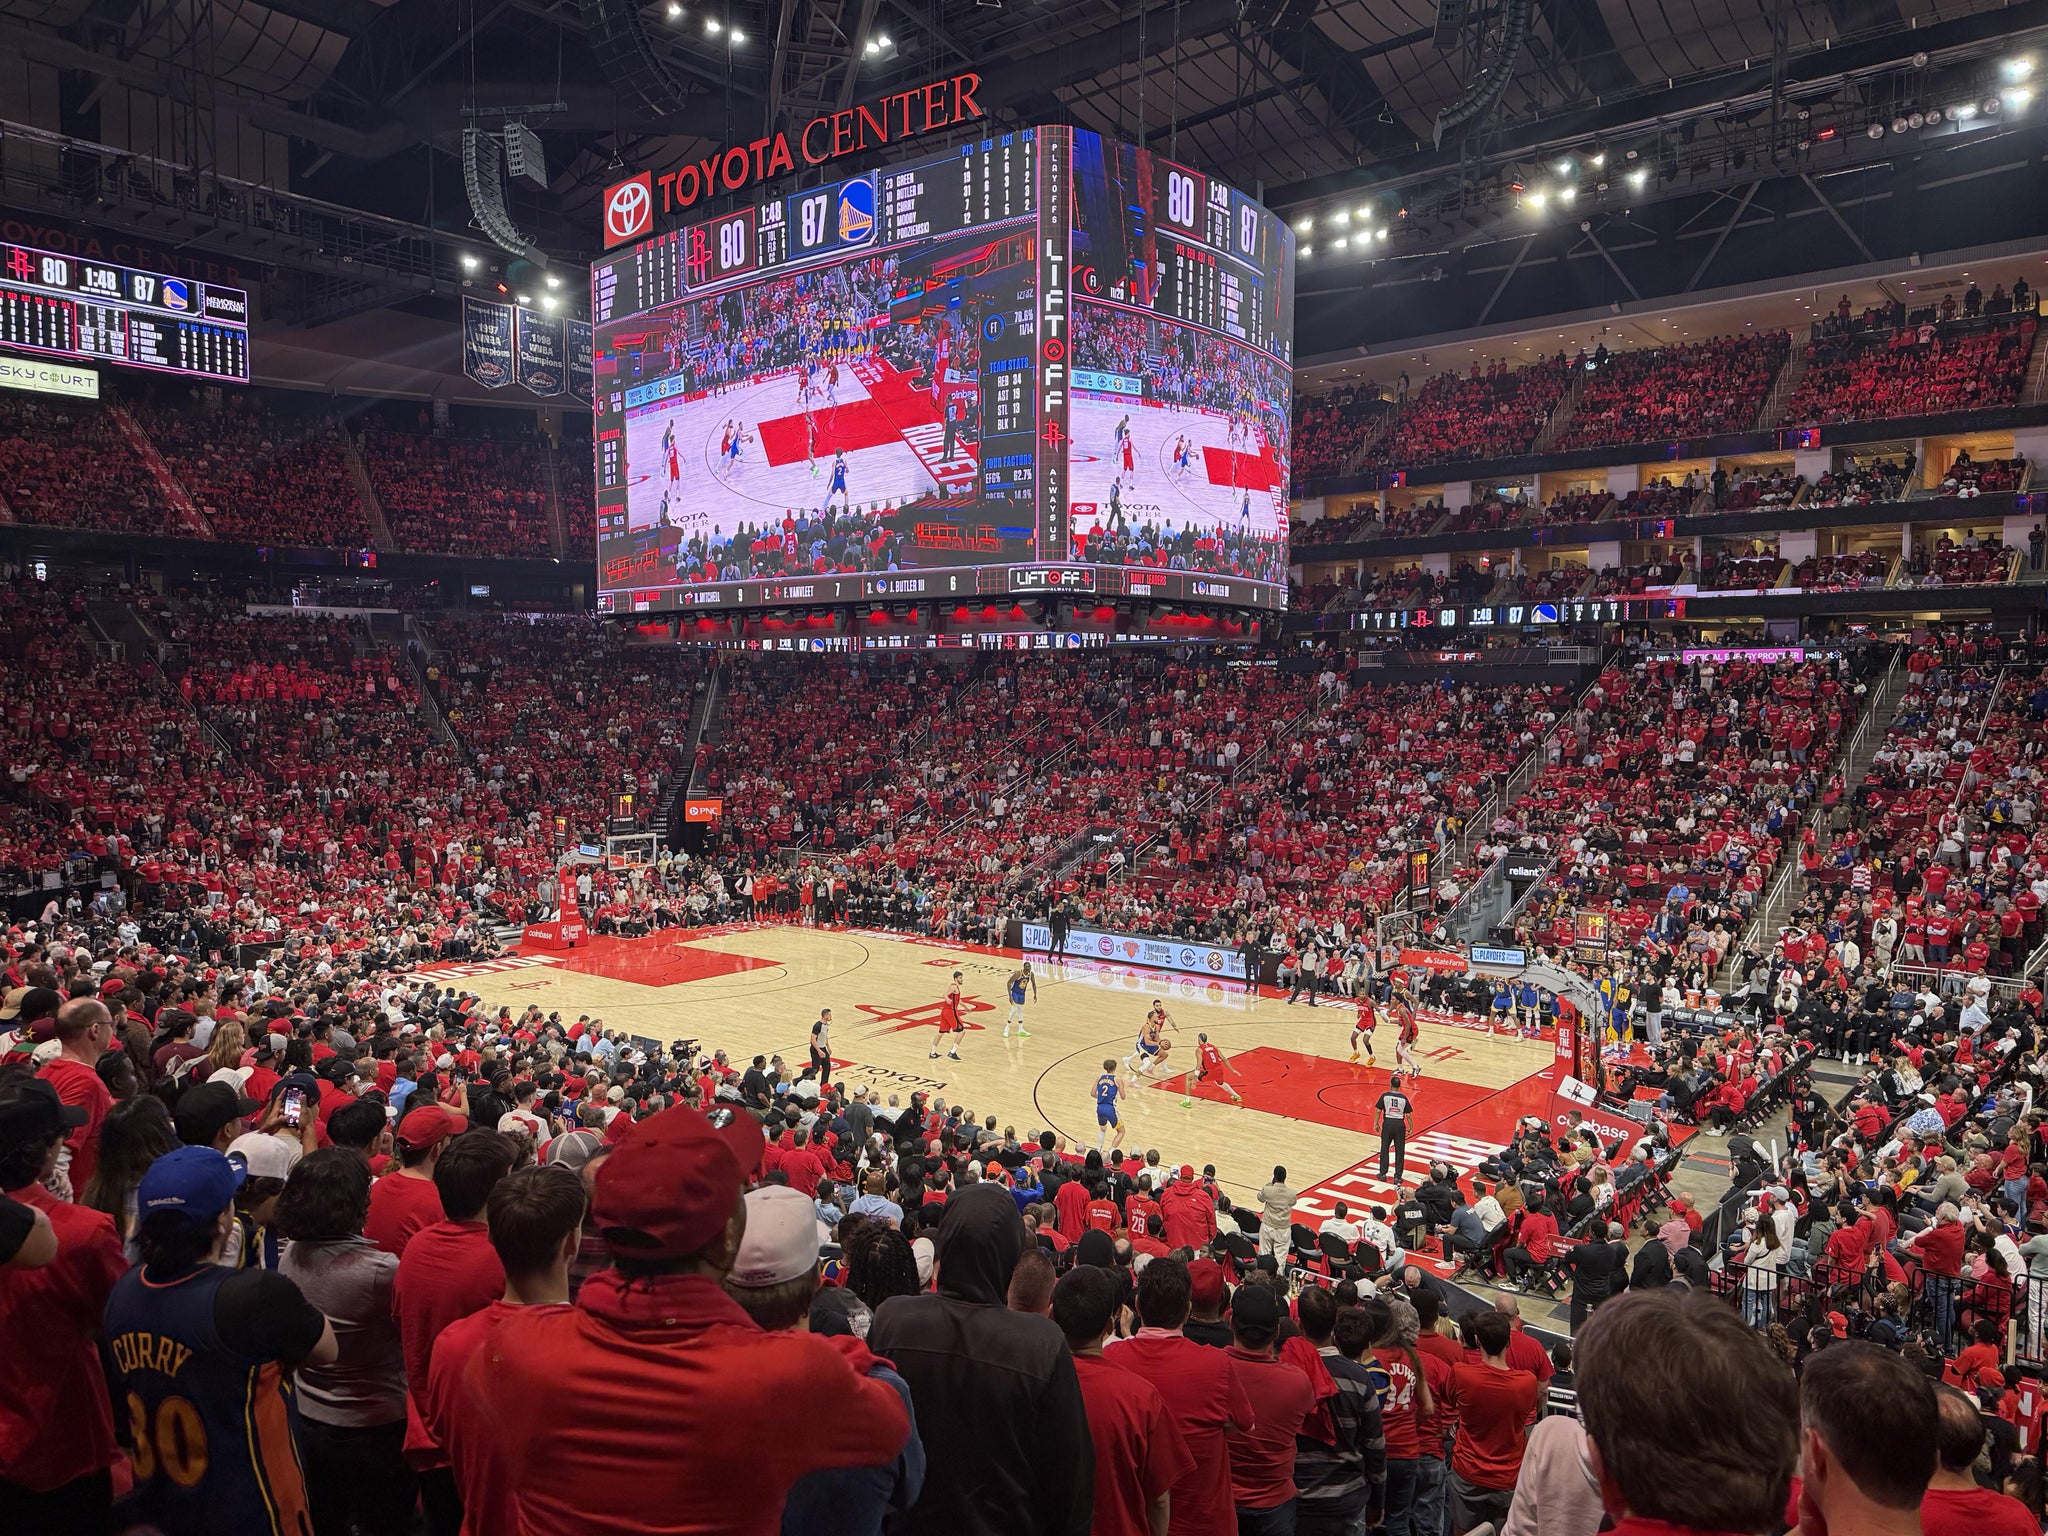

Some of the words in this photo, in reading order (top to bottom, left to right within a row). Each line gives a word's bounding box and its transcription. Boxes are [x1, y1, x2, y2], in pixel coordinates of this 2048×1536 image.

[658, 132, 795, 213] TOYOTA
[800, 72, 983, 165] CENTER
[961, 144, 974, 157] PTS
[981, 139, 993, 152] REB
[1001, 133, 1013, 147] AST
[964, 157, 970, 169] 4
[984, 153, 989, 165] 5
[1004, 147, 1009, 160] 2
[1025, 142, 1030, 155] 4
[886, 192, 893, 203] 10
[896, 185, 916, 201] BUTLER
[1025, 157, 1030, 169] 1
[963, 185, 971, 197] 31
[1024, 171, 1030, 183] 2
[1168, 171, 1194, 227] 80
[1210, 180, 1228, 207] 1:48
[761, 200, 782, 226] 1:48
[887, 217, 892, 229] 4
[965, 199, 970, 211] 7
[984, 194, 989, 206] 2
[1024, 185, 1030, 197] 3
[802, 194, 828, 247] 87
[887, 230, 892, 242] 2
[963, 212, 971, 224] 12
[1004, 203, 1009, 215] 5
[1024, 199, 1030, 211] 2
[781, 228, 786, 238] 2
[1241, 204, 1258, 256] 87
[720, 219, 745, 269] 80
[0, 219, 104, 257] OYOTA
[113, 243, 242, 287] CENTER
[42, 257, 67, 287] 80
[85, 267, 116, 291] 1:48
[135, 275, 155, 302] 87
[478, 322, 498, 335] 1997
[475, 332, 502, 347] WNBA
[531, 333, 552, 346] 1998
[466, 342, 510, 358] Champions
[529, 342, 554, 357] WNBA
[520, 351, 563, 368] Champions
[989, 361, 1007, 374] TEAM
[1008, 356, 1029, 371] STATS
[0, 364, 35, 380] SKY
[40, 371, 95, 388] COURT
[998, 375, 1009, 387] REB
[1013, 373, 1021, 385] 34
[998, 390, 1009, 402] AST
[998, 404, 1008, 416] STL
[1013, 402, 1020, 414] 13
[998, 419, 1008, 430] BLK
[986, 457, 1002, 469] FOUR
[1003, 453, 1032, 467] FACTORS
[1048, 468, 1058, 522] ALWAYS
[1049, 526, 1057, 541] US
[867, 582, 873, 594] 3.
[896, 580, 917, 592] BUTLER
[950, 576, 956, 590] 6
[1130, 573, 1145, 583] DAILY
[1147, 575, 1167, 586] LEADERS
[738, 589, 743, 601] 9
[836, 583, 840, 596] 7
[1441, 610, 1456, 626] 80
[1473, 608, 1492, 621] 1:48
[1509, 607, 1523, 623] 87
[799, 639, 808, 652] 87
[1019, 636, 1028, 649] 80
[1036, 635, 1048, 646] 1:48
[1055, 635, 1064, 649] 87
[620, 803, 631, 816] 11
[700, 807, 718, 815] PNC
[1509, 867, 1539, 877] reliant
[1588, 917, 1603, 927] 1:48
[528, 930, 553, 940] coinbase
[1588, 929, 1600, 937] 11
[1071, 941, 1094, 952] Google
[1584, 939, 1606, 947] TISSOT
[1480, 950, 1505, 962] PLAYOFFS
[403, 954, 568, 984] OUSTON
[1559, 1028, 1570, 1038] GET
[1559, 1038, 1570, 1048] THE
[856, 1064, 948, 1090] TOYOTA
[1102, 1085, 1108, 1097] 2
[1404, 1210, 1423, 1219] MEDIA
[1131, 1215, 1145, 1234] 28
[112, 1332, 192, 1378] CURRY
[1382, 1382, 1411, 1411] 34
